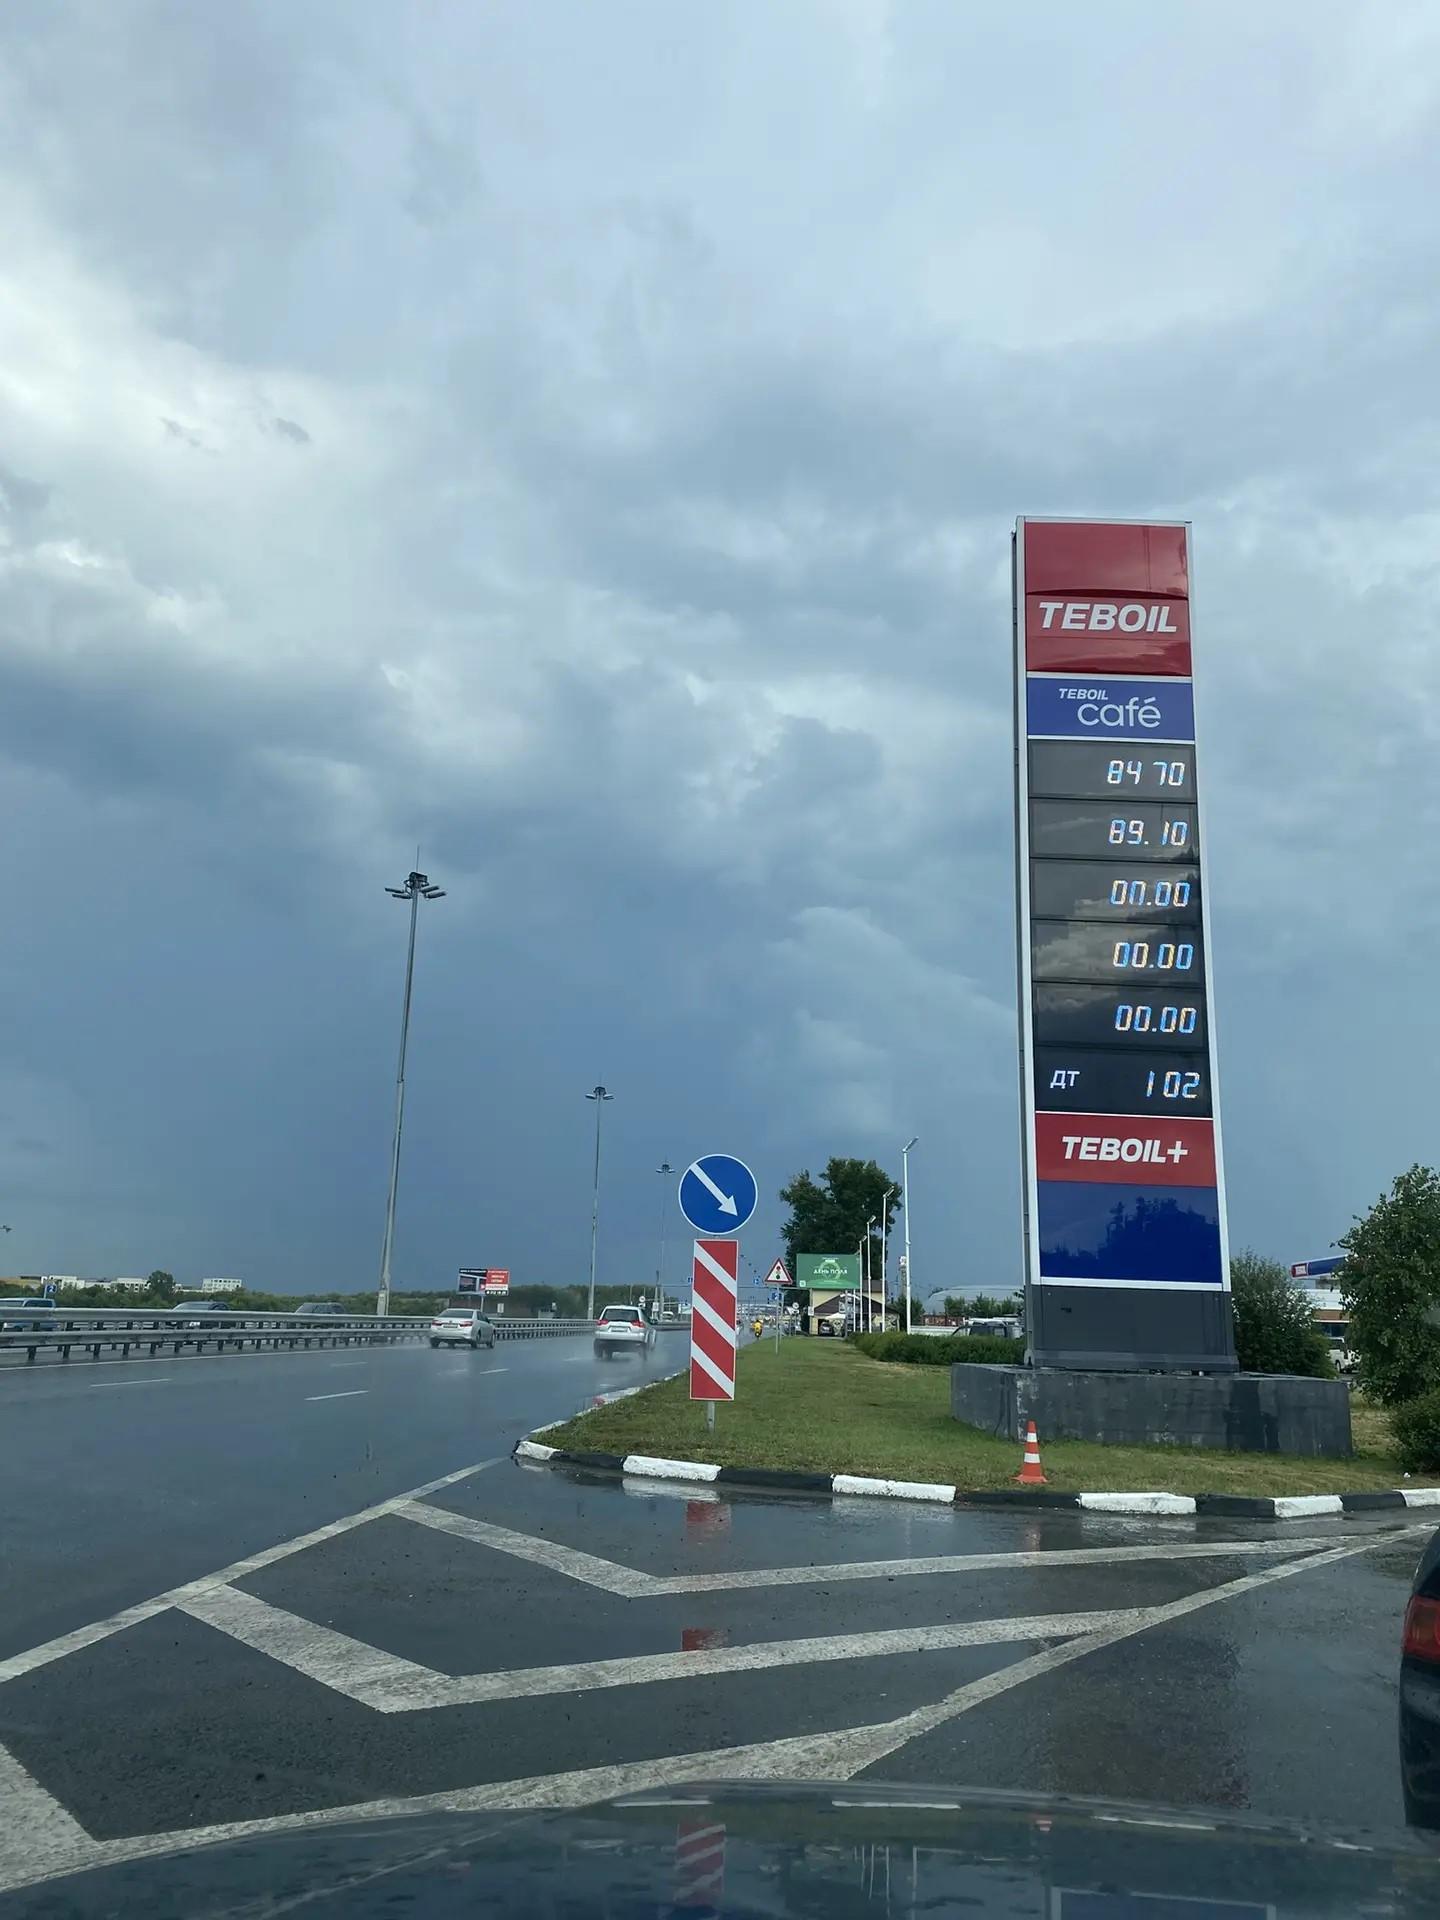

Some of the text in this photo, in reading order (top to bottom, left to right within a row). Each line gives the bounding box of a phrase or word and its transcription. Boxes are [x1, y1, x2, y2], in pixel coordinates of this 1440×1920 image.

[1039, 602, 1177, 633] TEBOIL
[1058, 688, 1109, 700] TEBOIL
[1077, 697, 1162, 728] café
[1112, 942, 1194, 970] 00.00
[1114, 1004, 1197, 1034] 00.00
[1050, 1070, 1080, 1089] ДТ
[1062, 1136, 1188, 1163] TEBOIL+
